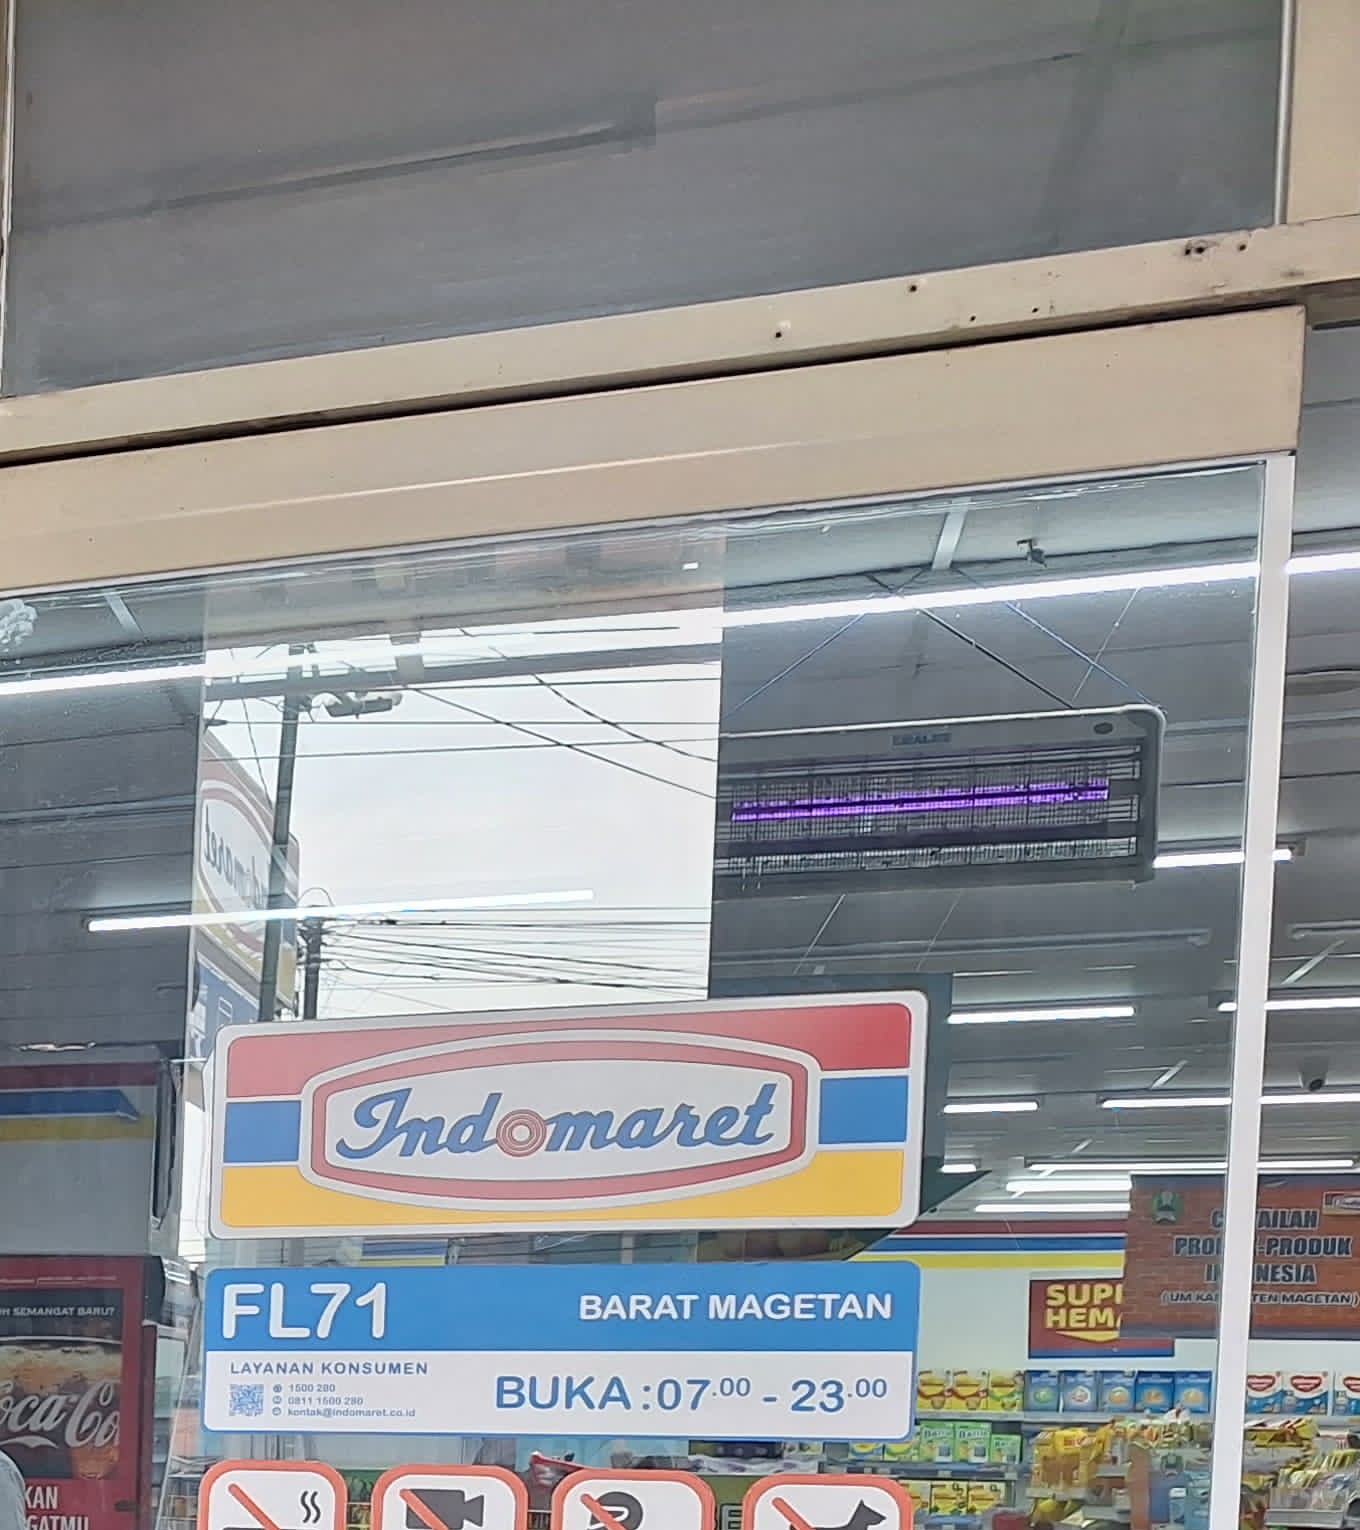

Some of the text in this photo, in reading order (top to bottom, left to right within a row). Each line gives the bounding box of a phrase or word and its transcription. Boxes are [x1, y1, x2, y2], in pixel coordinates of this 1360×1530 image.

[335, 1082, 779, 1160] Indomaret
[1211, 1208, 1319, 1230] CAILAH
[1173, 1235, 1353, 1257] PRO-PRODUK
[1204, 1263, 1318, 1284] INESIA
[1046, 1283, 1124, 1305] SUP
[12, 1306, 75, 1317] SEMANGAT
[222, 1283, 387, 1339] FL71
[579, 1292, 893, 1321] BARAT MAGETAN
[1045, 1307, 1124, 1328] HEM
[230, 1362, 428, 1375] LAYANAN KONSUMEN
[494, 1375, 632, 1411] BUKA
[790, 1377, 888, 1413] 23.00
[288, 1408, 417, 1418] kontak@indomaret.co.id
[25, 1486, 58, 1510] KAN
